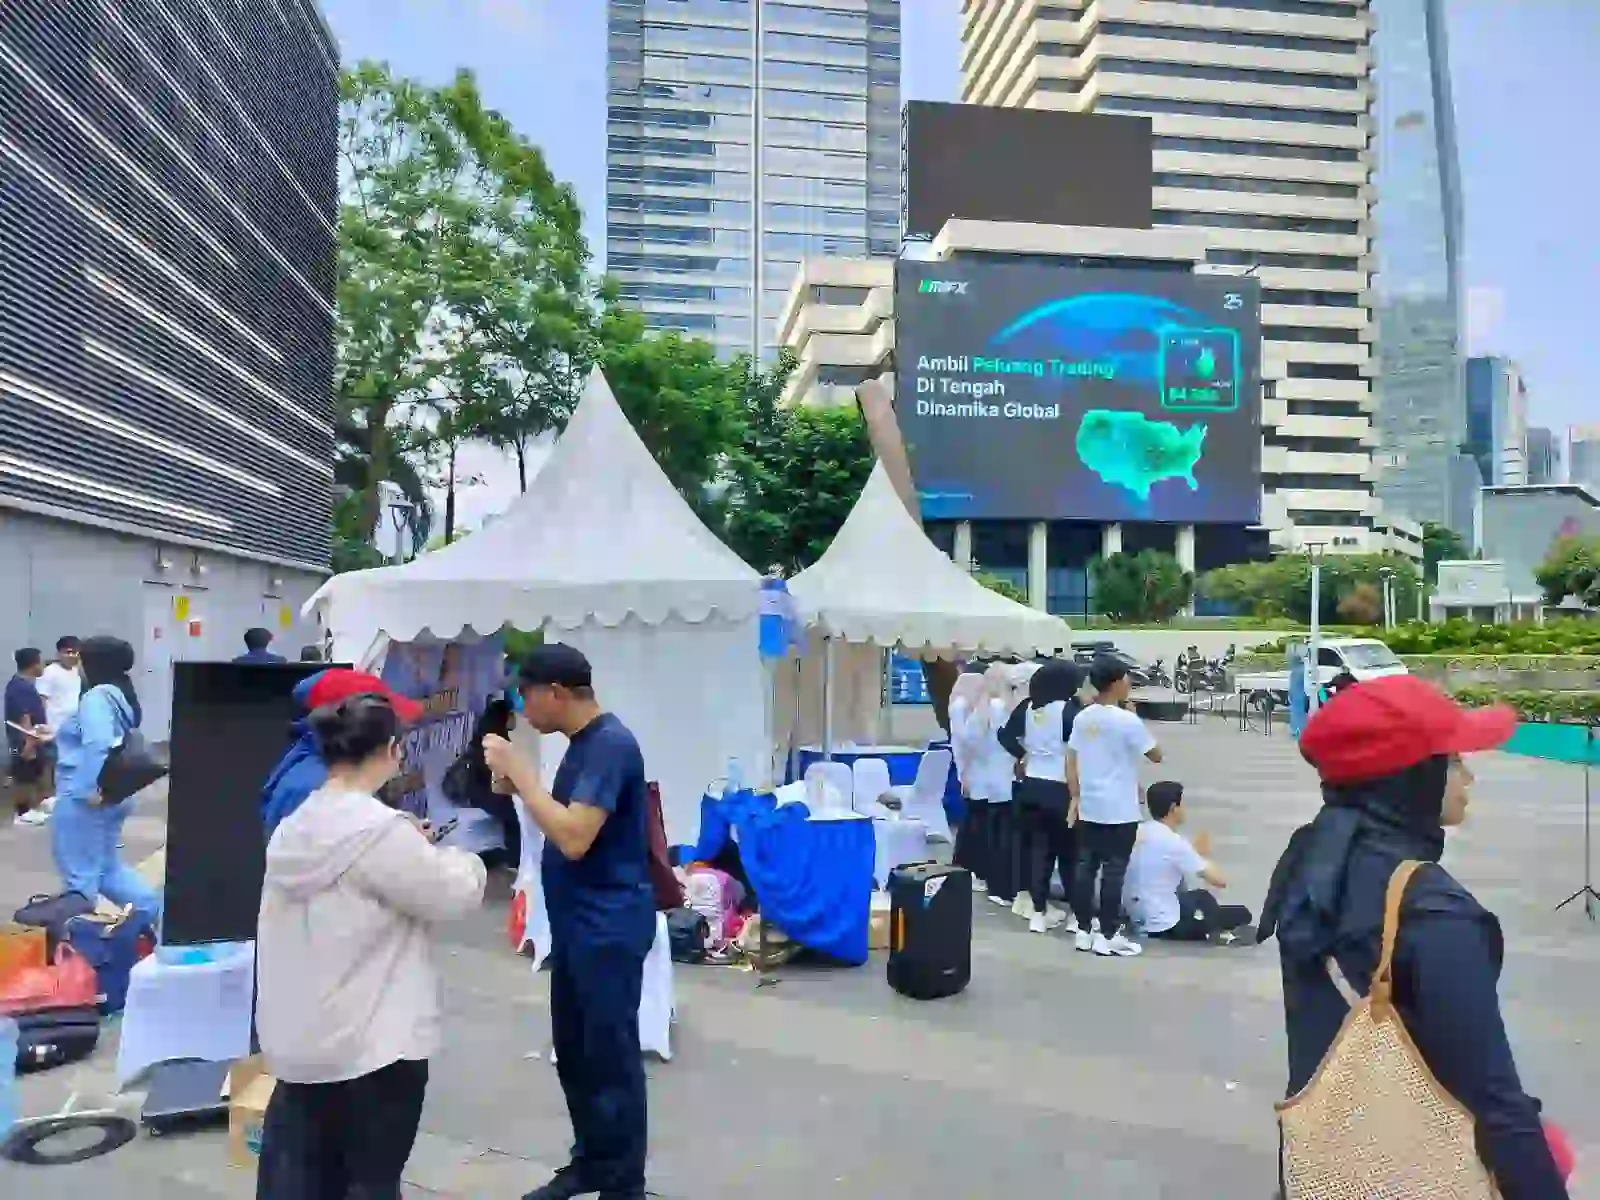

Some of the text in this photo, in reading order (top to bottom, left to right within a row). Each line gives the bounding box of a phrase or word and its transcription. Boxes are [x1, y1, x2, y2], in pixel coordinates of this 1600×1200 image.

[917, 355, 968, 373] Ambil
[1048, 359, 1115, 380] Trading
[917, 377, 1005, 398] Di Tengah
[917, 400, 1060, 419] Dinamika Global
